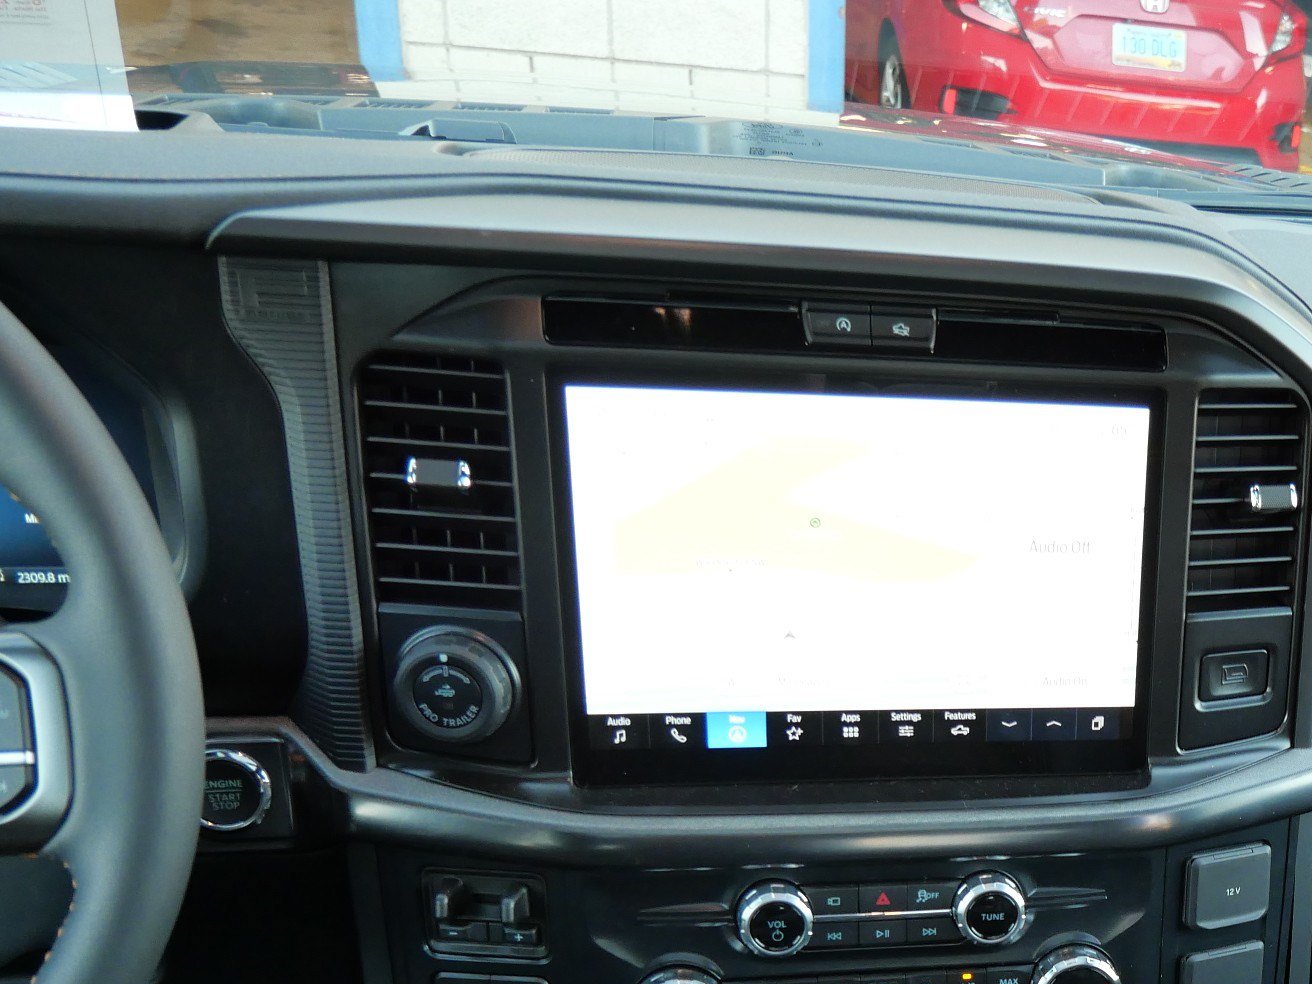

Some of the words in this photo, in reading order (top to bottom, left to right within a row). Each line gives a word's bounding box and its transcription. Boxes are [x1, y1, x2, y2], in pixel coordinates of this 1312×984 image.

[17, 571, 56, 584] 2309.8
[418, 702, 439, 722] PRO
[442, 705, 480, 727] TRAILER
[787, 714, 802, 723] Fav
[841, 713, 861, 723] Apps
[891, 711, 922, 722] Settings
[944, 711, 976, 721] Features
[607, 716, 631, 727] Audio
[665, 715, 692, 725] Phone
[926, 891, 940, 900] OFF
[1226, 888, 1235, 896] 12
[1235, 886, 1241, 895] V
[981, 912, 1005, 922] TUNE
[768, 919, 788, 929] VOL
